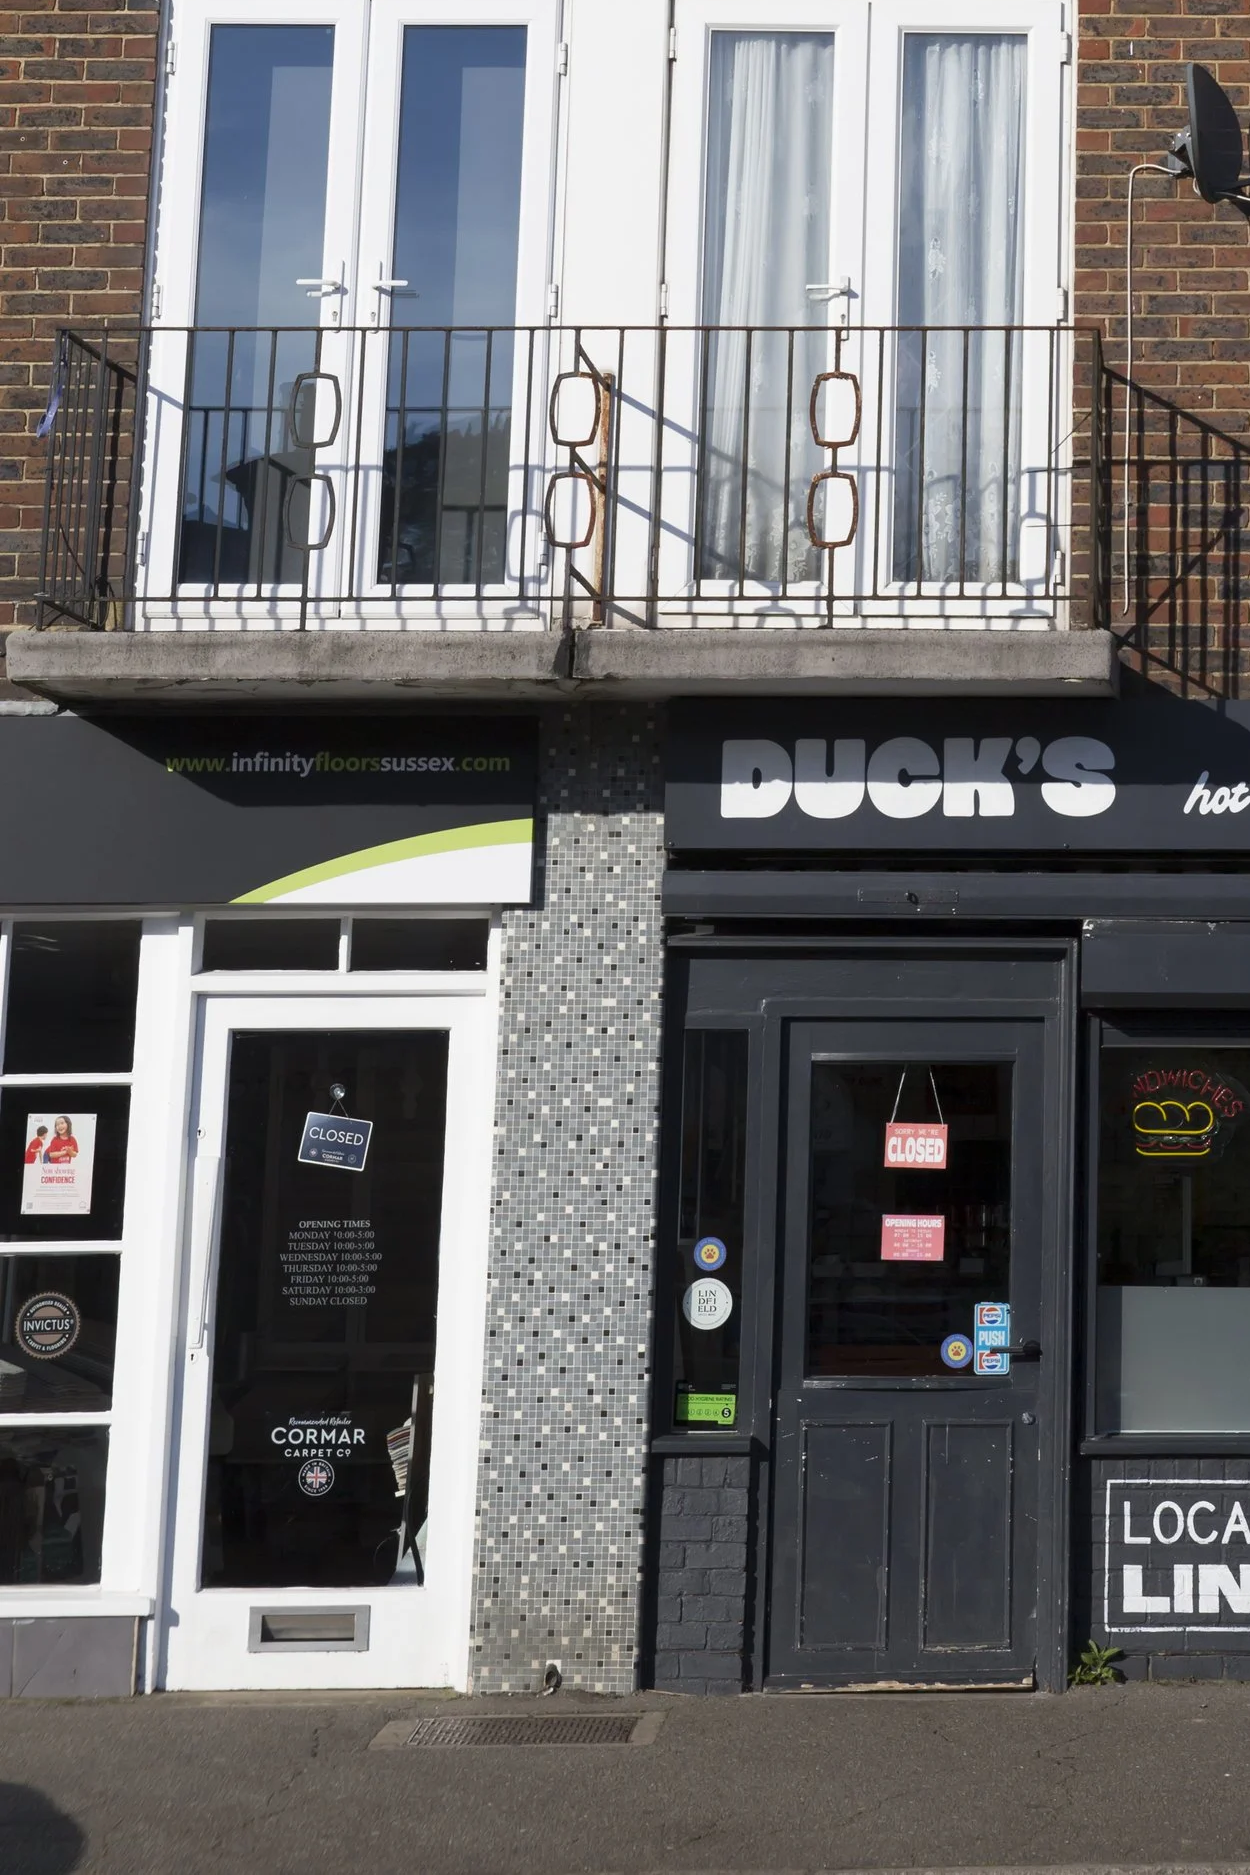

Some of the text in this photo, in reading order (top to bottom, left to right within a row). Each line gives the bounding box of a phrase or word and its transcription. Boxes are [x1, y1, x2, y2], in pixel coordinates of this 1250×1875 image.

[165, 751, 511, 777] www.infinityfloorssussex.com
[721, 736, 1116, 819] DUCK'S
[309, 1126, 364, 1146] CLOSED
[887, 1136, 945, 1163] CLOSED
[41, 1176, 75, 1184] CONFIDENCE
[299, 1220, 371, 1228] OPENING TIMES
[885, 1218, 942, 1228] OPENING HOURS
[289, 1231, 331, 1239] MONDAY
[288, 1242, 331, 1250] TUESDAY
[279, 1253, 382, 1261] WEDNESDAY 10:00-5:00
[283, 1264, 377, 1272] THURSDAY 10:00-5:00
[290, 1275, 369, 1283] FRIDAY 10:00-5:00
[282, 1286, 376, 1295] SATURDAY 10:00-3:00
[289, 1297, 367, 1306] SUNDAY CLOSED
[979, 1331, 1006, 1345] PUSH
[27, 1338, 42, 1350] CARPET
[723, 1408, 730, 1417] 5
[289, 1417, 329, 1426] Recommended
[271, 1426, 366, 1444] CORMAR
[284, 1449, 333, 1457] CARPET
